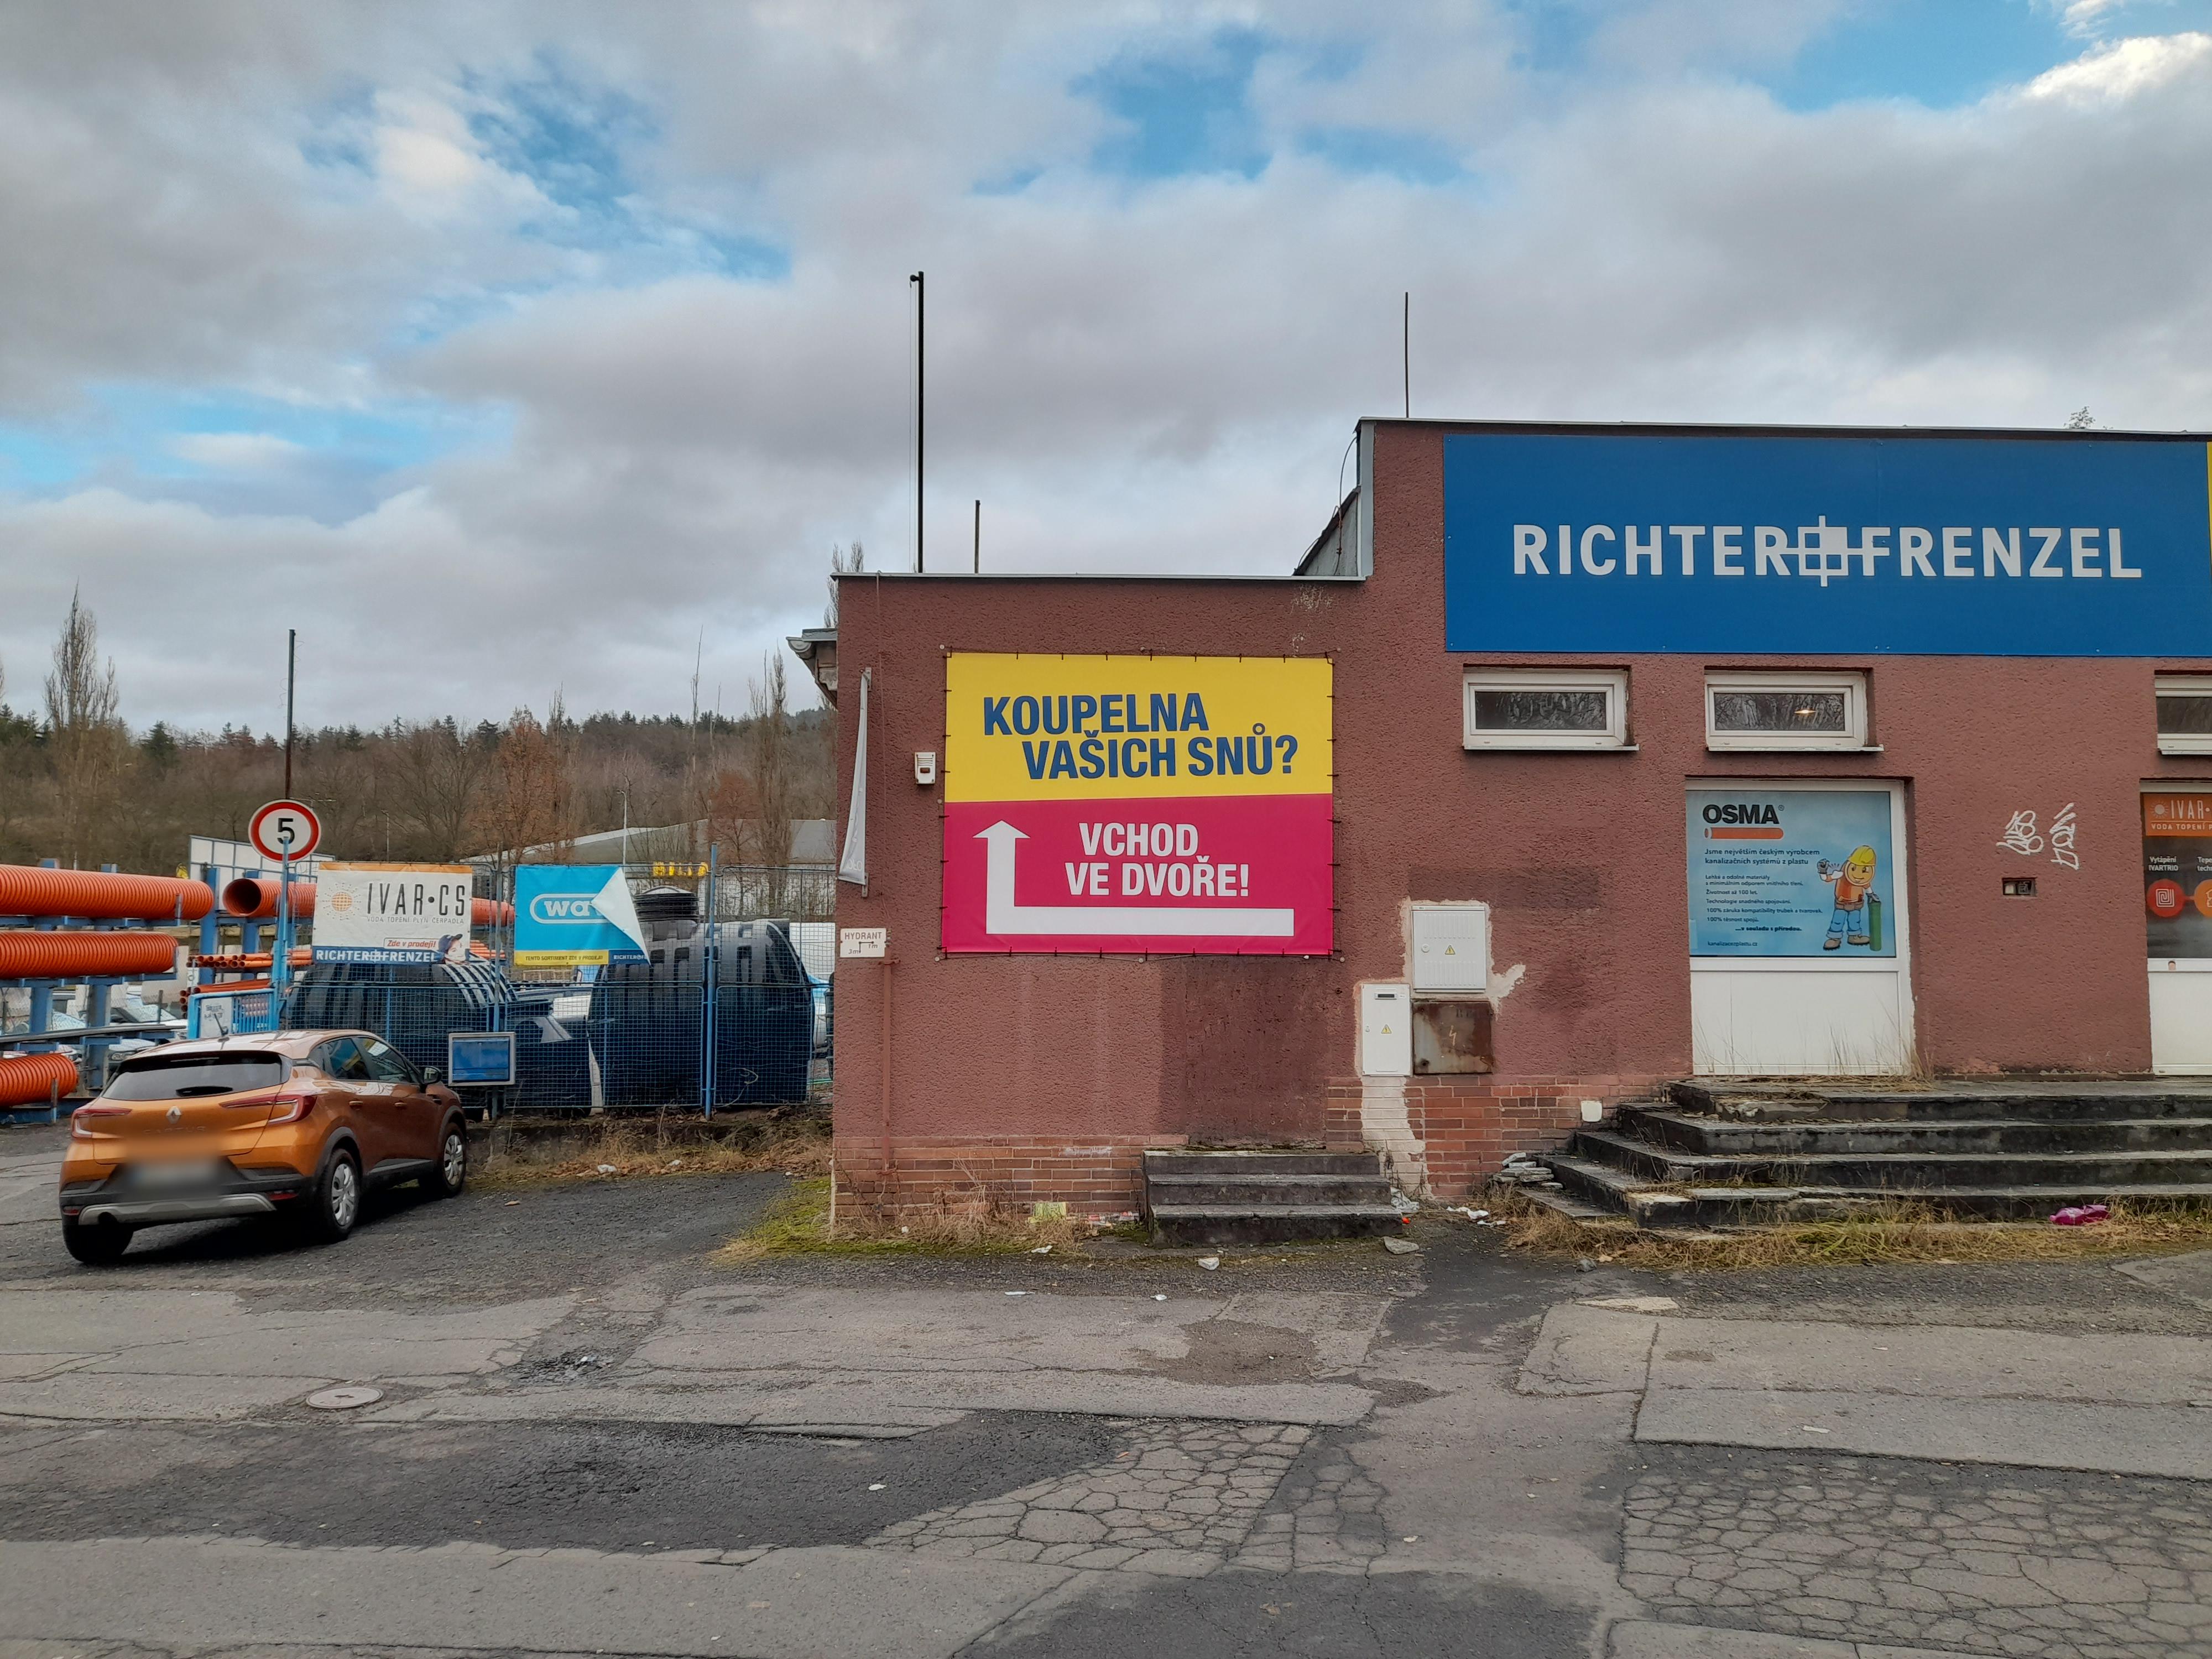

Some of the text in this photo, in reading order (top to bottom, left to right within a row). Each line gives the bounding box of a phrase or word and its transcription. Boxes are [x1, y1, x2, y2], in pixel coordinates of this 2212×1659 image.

[983, 693, 1209, 735] KOUPELNA
[1021, 723, 1298, 779] VAŠICH SNŮ?
[277, 818, 295, 844] 5
[1079, 822, 1198, 857] VCHOD
[1724, 848, 1757, 857] největším
[1759, 848, 1785, 857] českým
[1787, 848, 1820, 857] výrobcem
[1065, 855, 1249, 897] VE DVOŘE!
